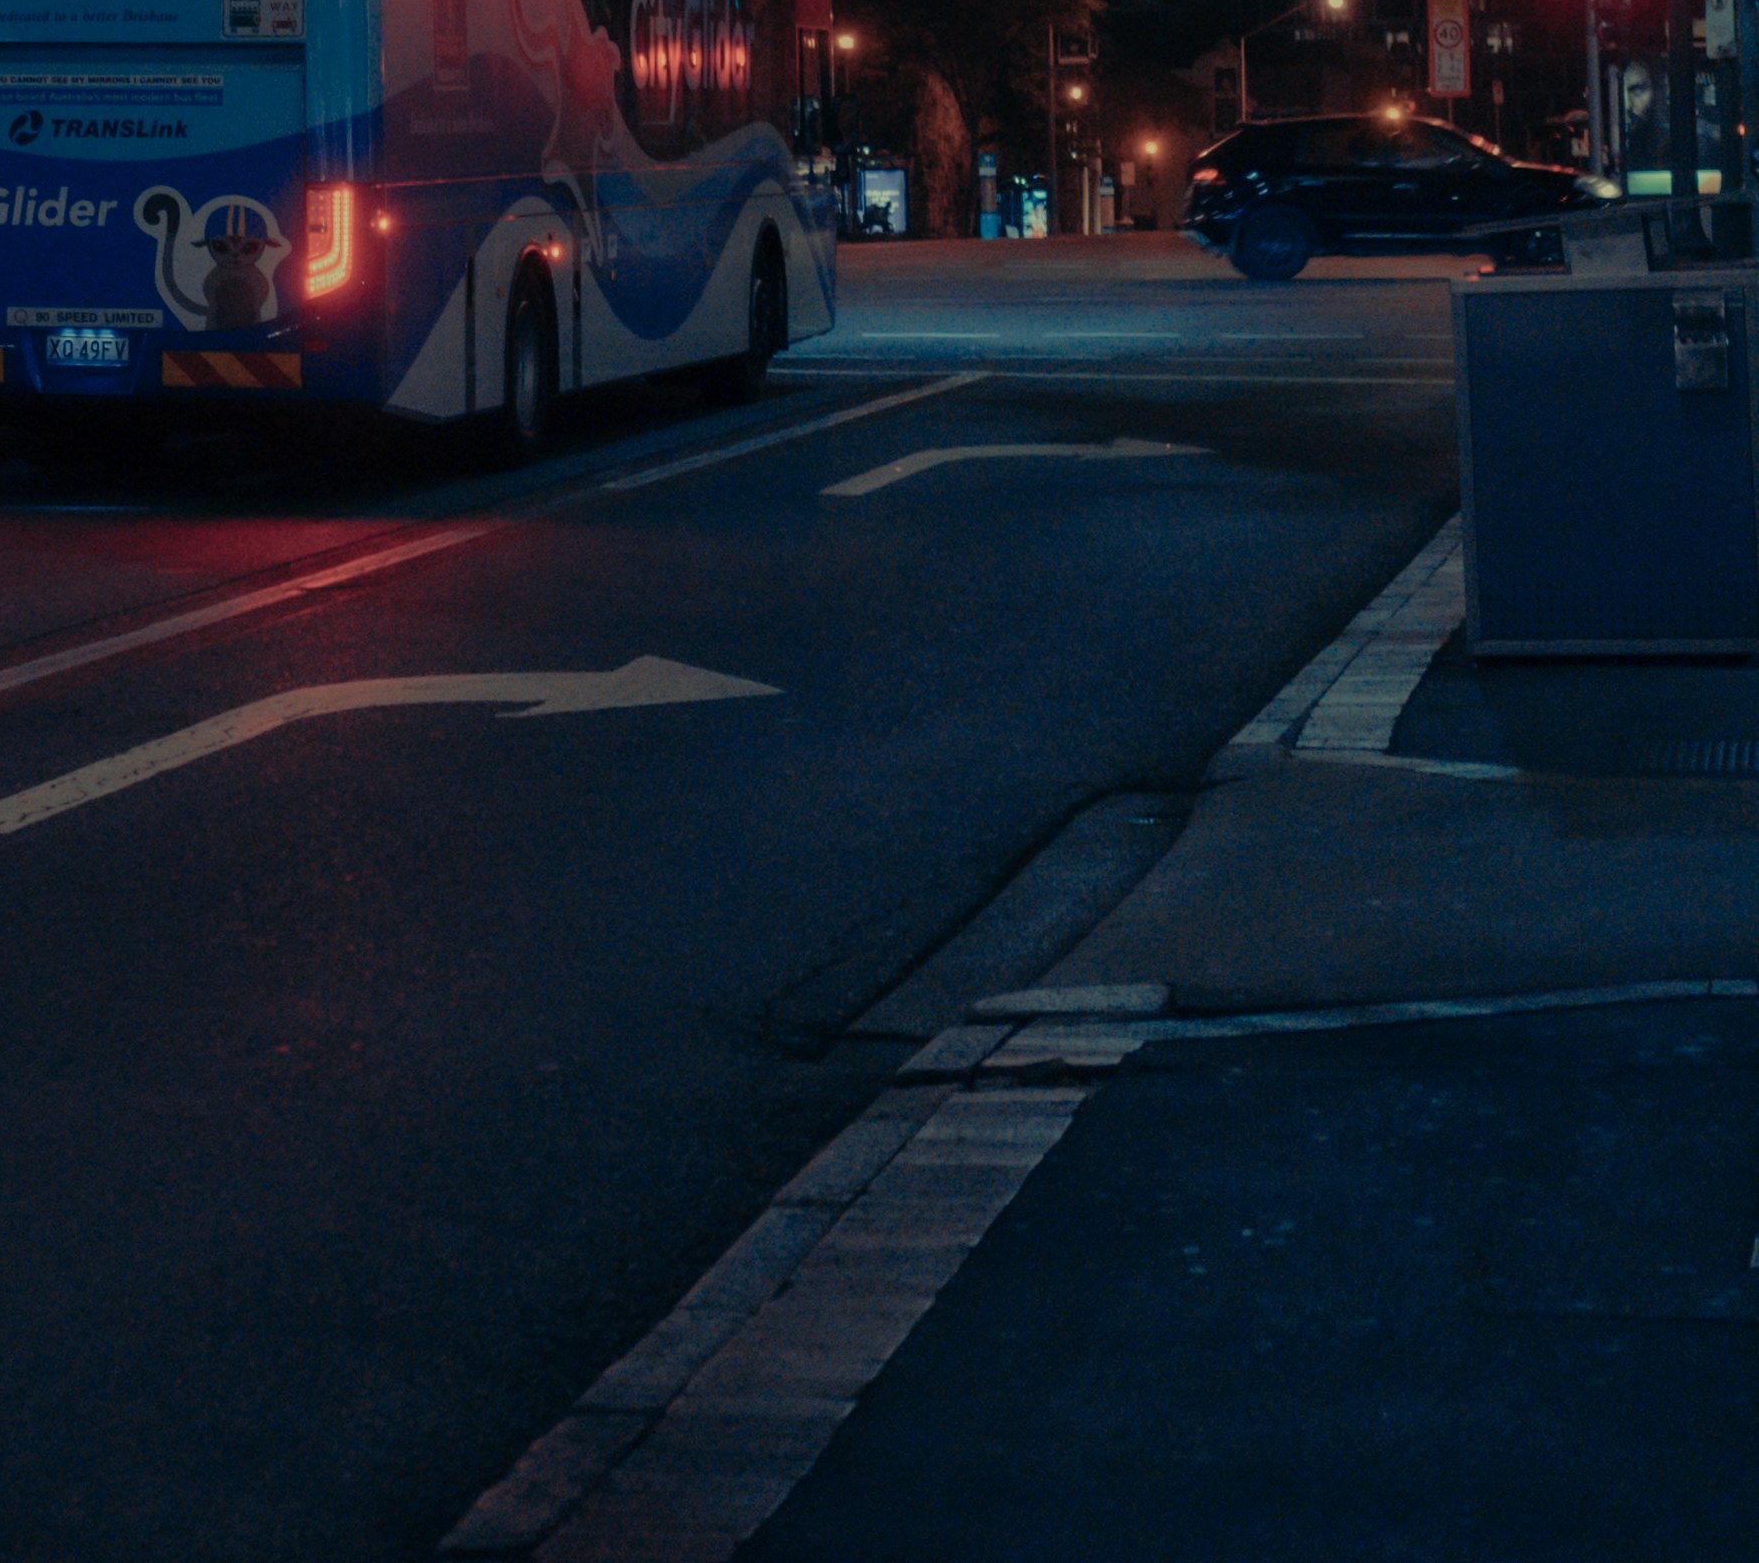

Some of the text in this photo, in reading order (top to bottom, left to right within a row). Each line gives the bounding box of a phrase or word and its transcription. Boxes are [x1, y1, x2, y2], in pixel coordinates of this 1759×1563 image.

[270, 2, 300, 12] WAY
[123, 9, 180, 23] Brisbane
[1440, 26, 1460, 41] 40
[10, 75, 48, 84] CANNOT
[51, 75, 68, 84] SEE
[71, 75, 85, 84] MY
[88, 75, 130, 84] MIRRORS
[140, 75, 179, 84] CANNOT
[182, 75, 199, 84] SEE
[201, 75, 221, 84] YOU
[52, 117, 189, 138] TRANSLink
[36, 313, 154, 323] 90 SPEED LIMITED
